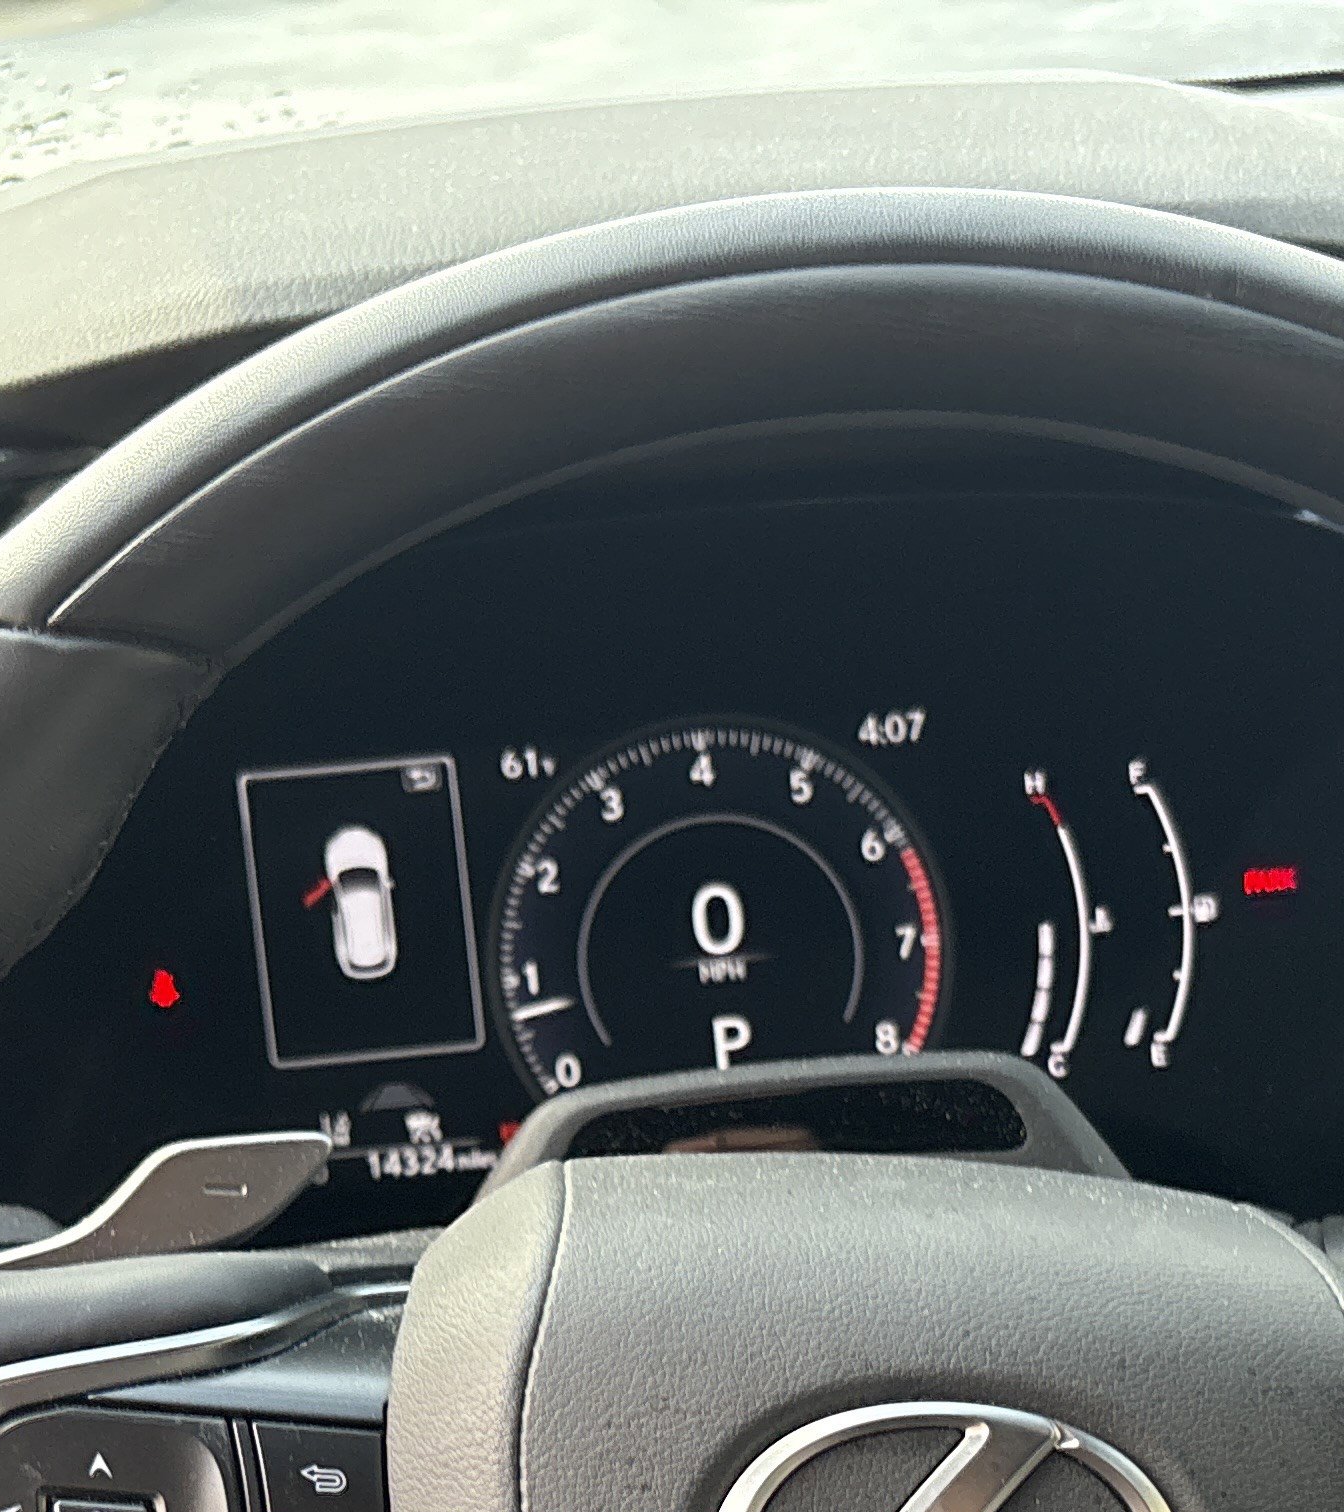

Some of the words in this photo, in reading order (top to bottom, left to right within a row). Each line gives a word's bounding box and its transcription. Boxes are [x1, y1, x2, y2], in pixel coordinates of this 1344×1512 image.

[858, 708, 926, 746] 4:07
[690, 756, 716, 787] 4
[791, 770, 814, 804] 5
[600, 786, 624, 823] 3
[862, 829, 885, 862] 6
[537, 860, 560, 895] 2
[691, 882, 745, 955] 0
[895, 924, 916, 960] 7
[522, 960, 539, 996] 1
[713, 1016, 751, 1070] P
[875, 1022, 899, 1056] 8
[556, 1055, 581, 1088] 0
[368, 1143, 453, 1180] 14324
